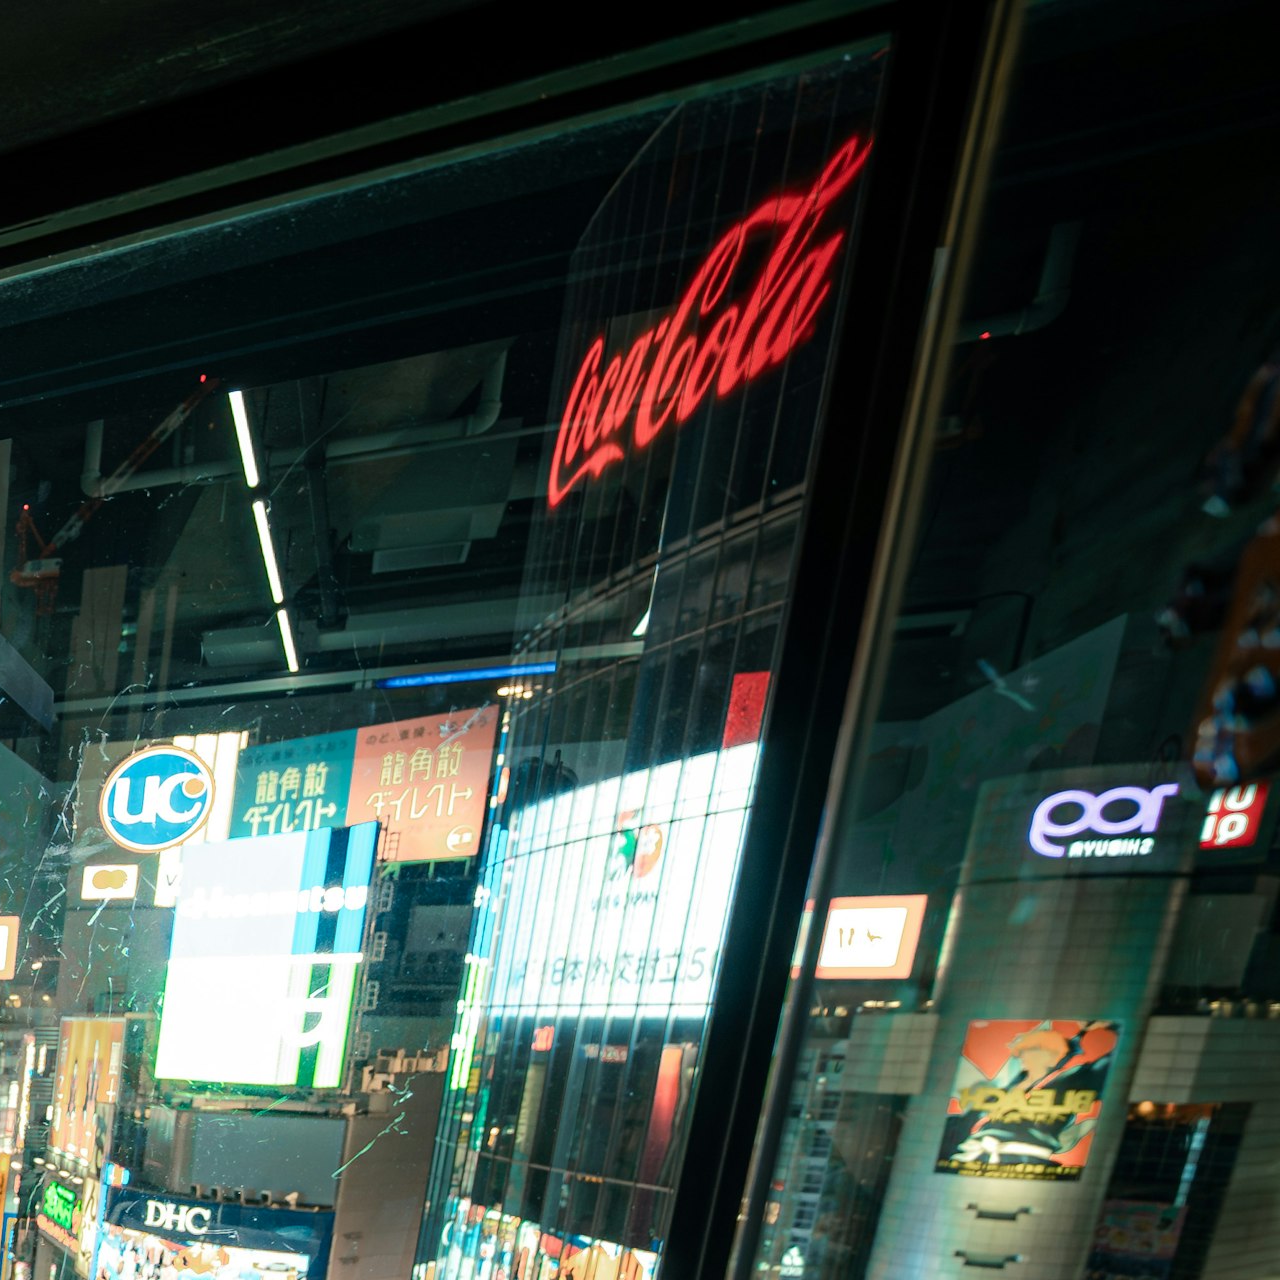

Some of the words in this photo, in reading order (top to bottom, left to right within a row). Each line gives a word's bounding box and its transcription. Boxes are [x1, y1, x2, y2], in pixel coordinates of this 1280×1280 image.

[549, 136, 873, 508] Coca-Cola
[255, 761, 329, 805] 龍角散
[378, 741, 465, 787] 龍角散
[113, 772, 208, 825] UC
[366, 782, 473, 822] ダイレクト
[144, 1200, 212, 1235] DHC
